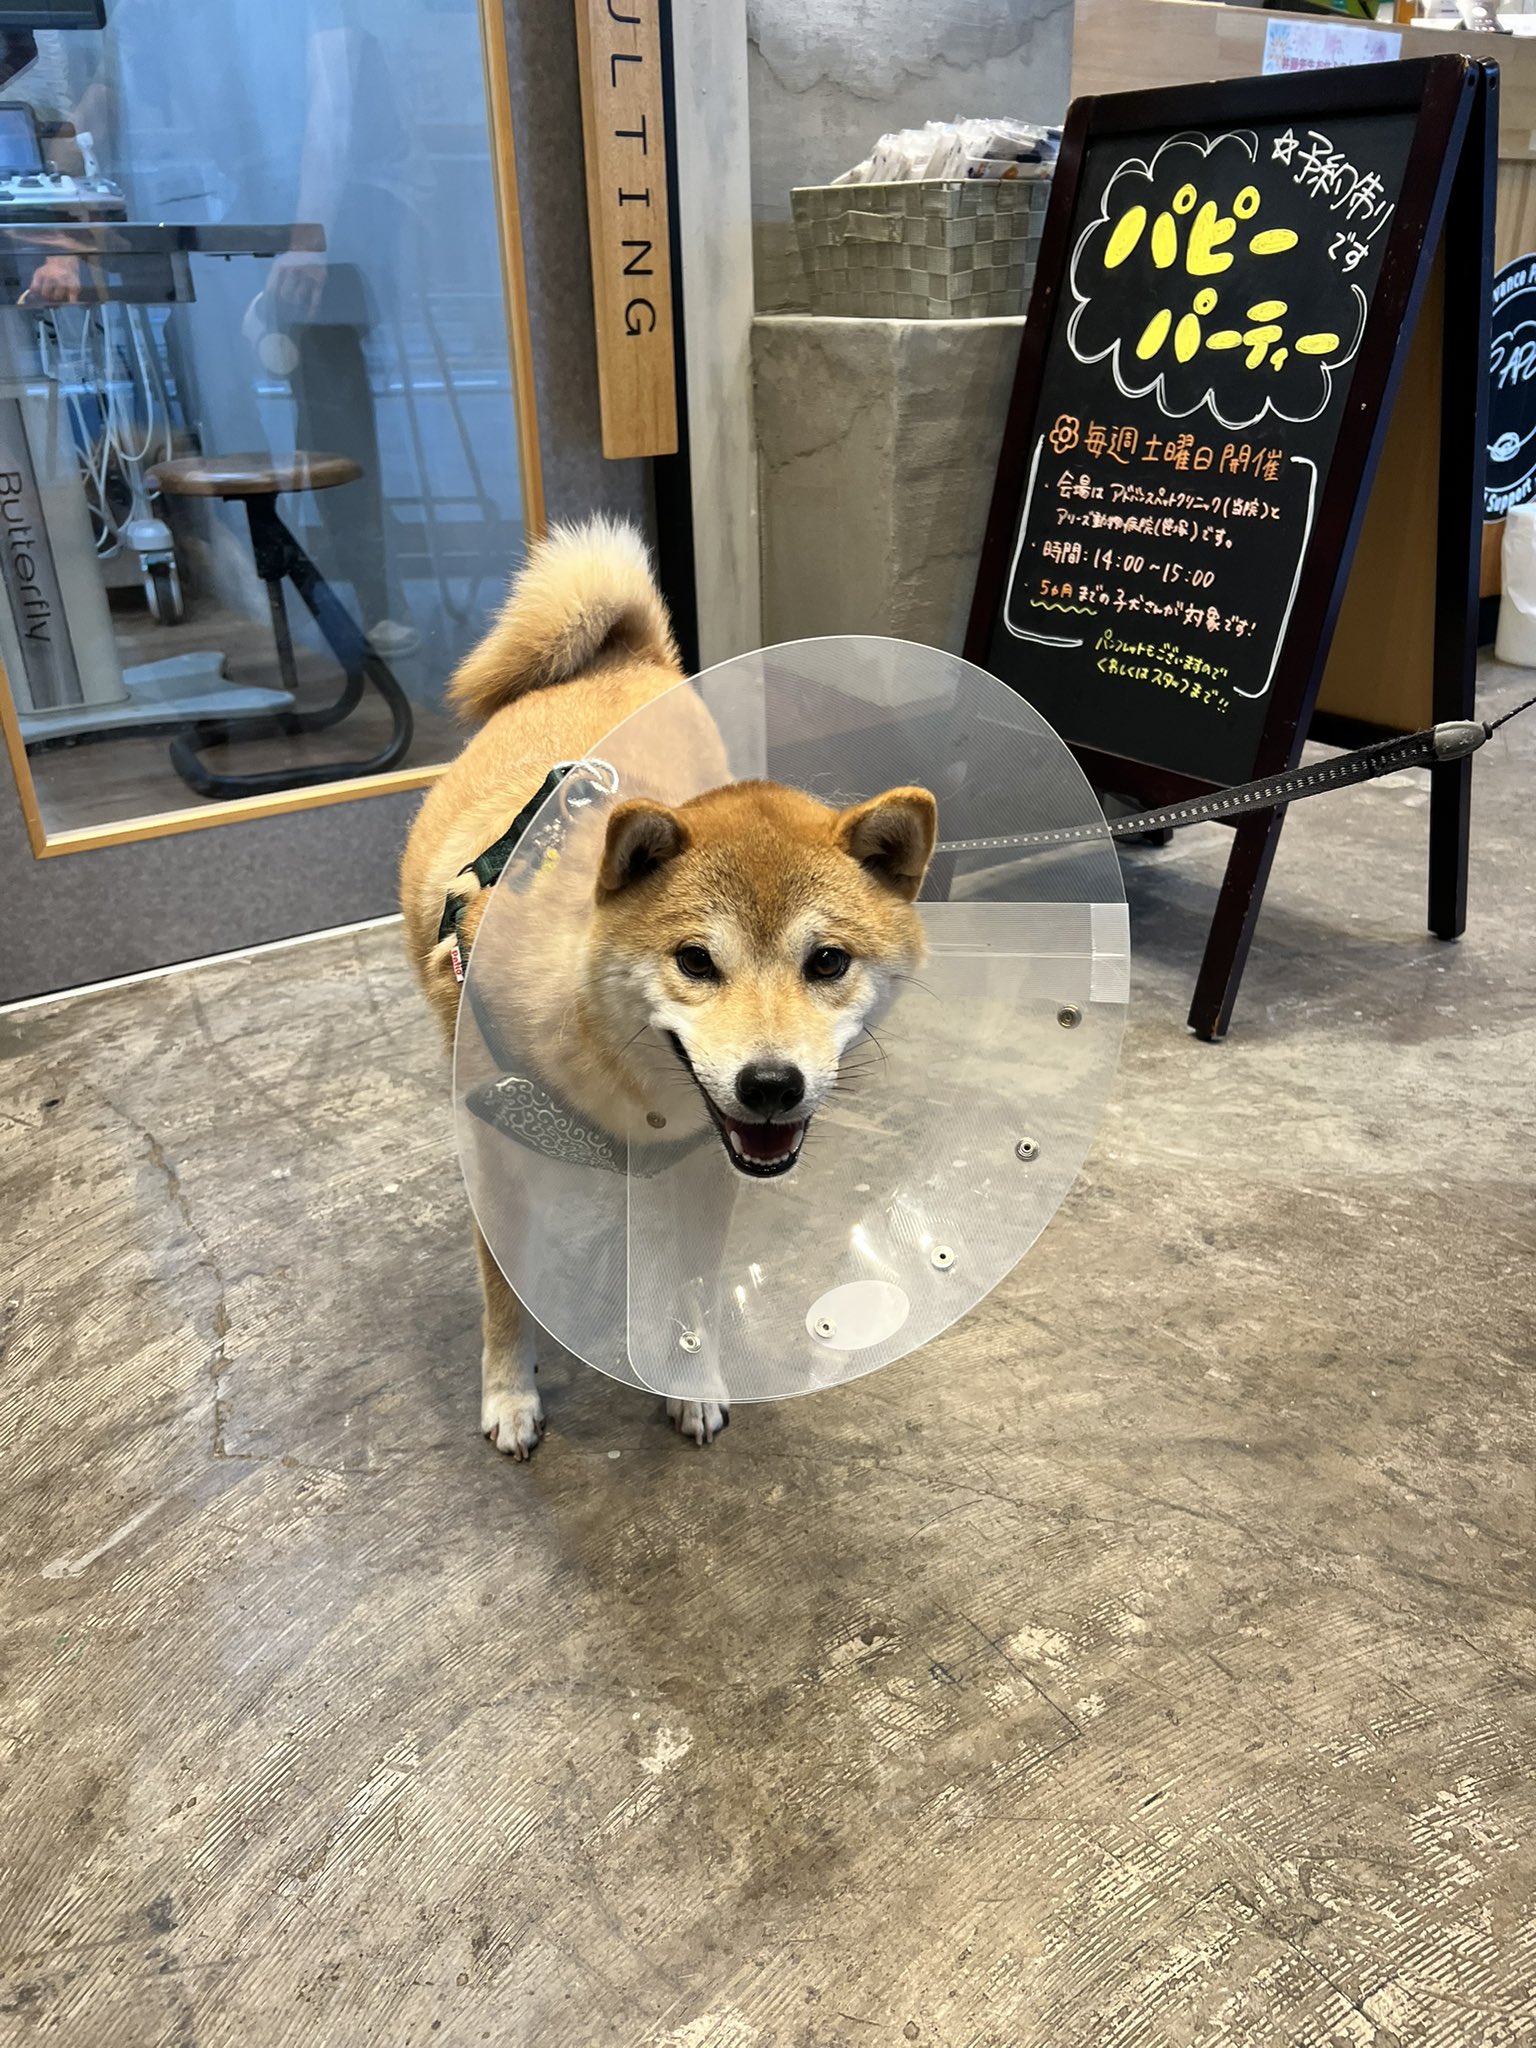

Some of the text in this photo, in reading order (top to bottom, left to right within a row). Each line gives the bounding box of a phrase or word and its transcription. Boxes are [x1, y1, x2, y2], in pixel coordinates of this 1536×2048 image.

[1104, 183, 1298, 276] パピー
[1327, 231, 1371, 272] です
[1136, 287, 1340, 373] パーティー
[1084, 421, 1283, 481] 毎週土曜日開催
[0, 472, 51, 642] Butterfly
